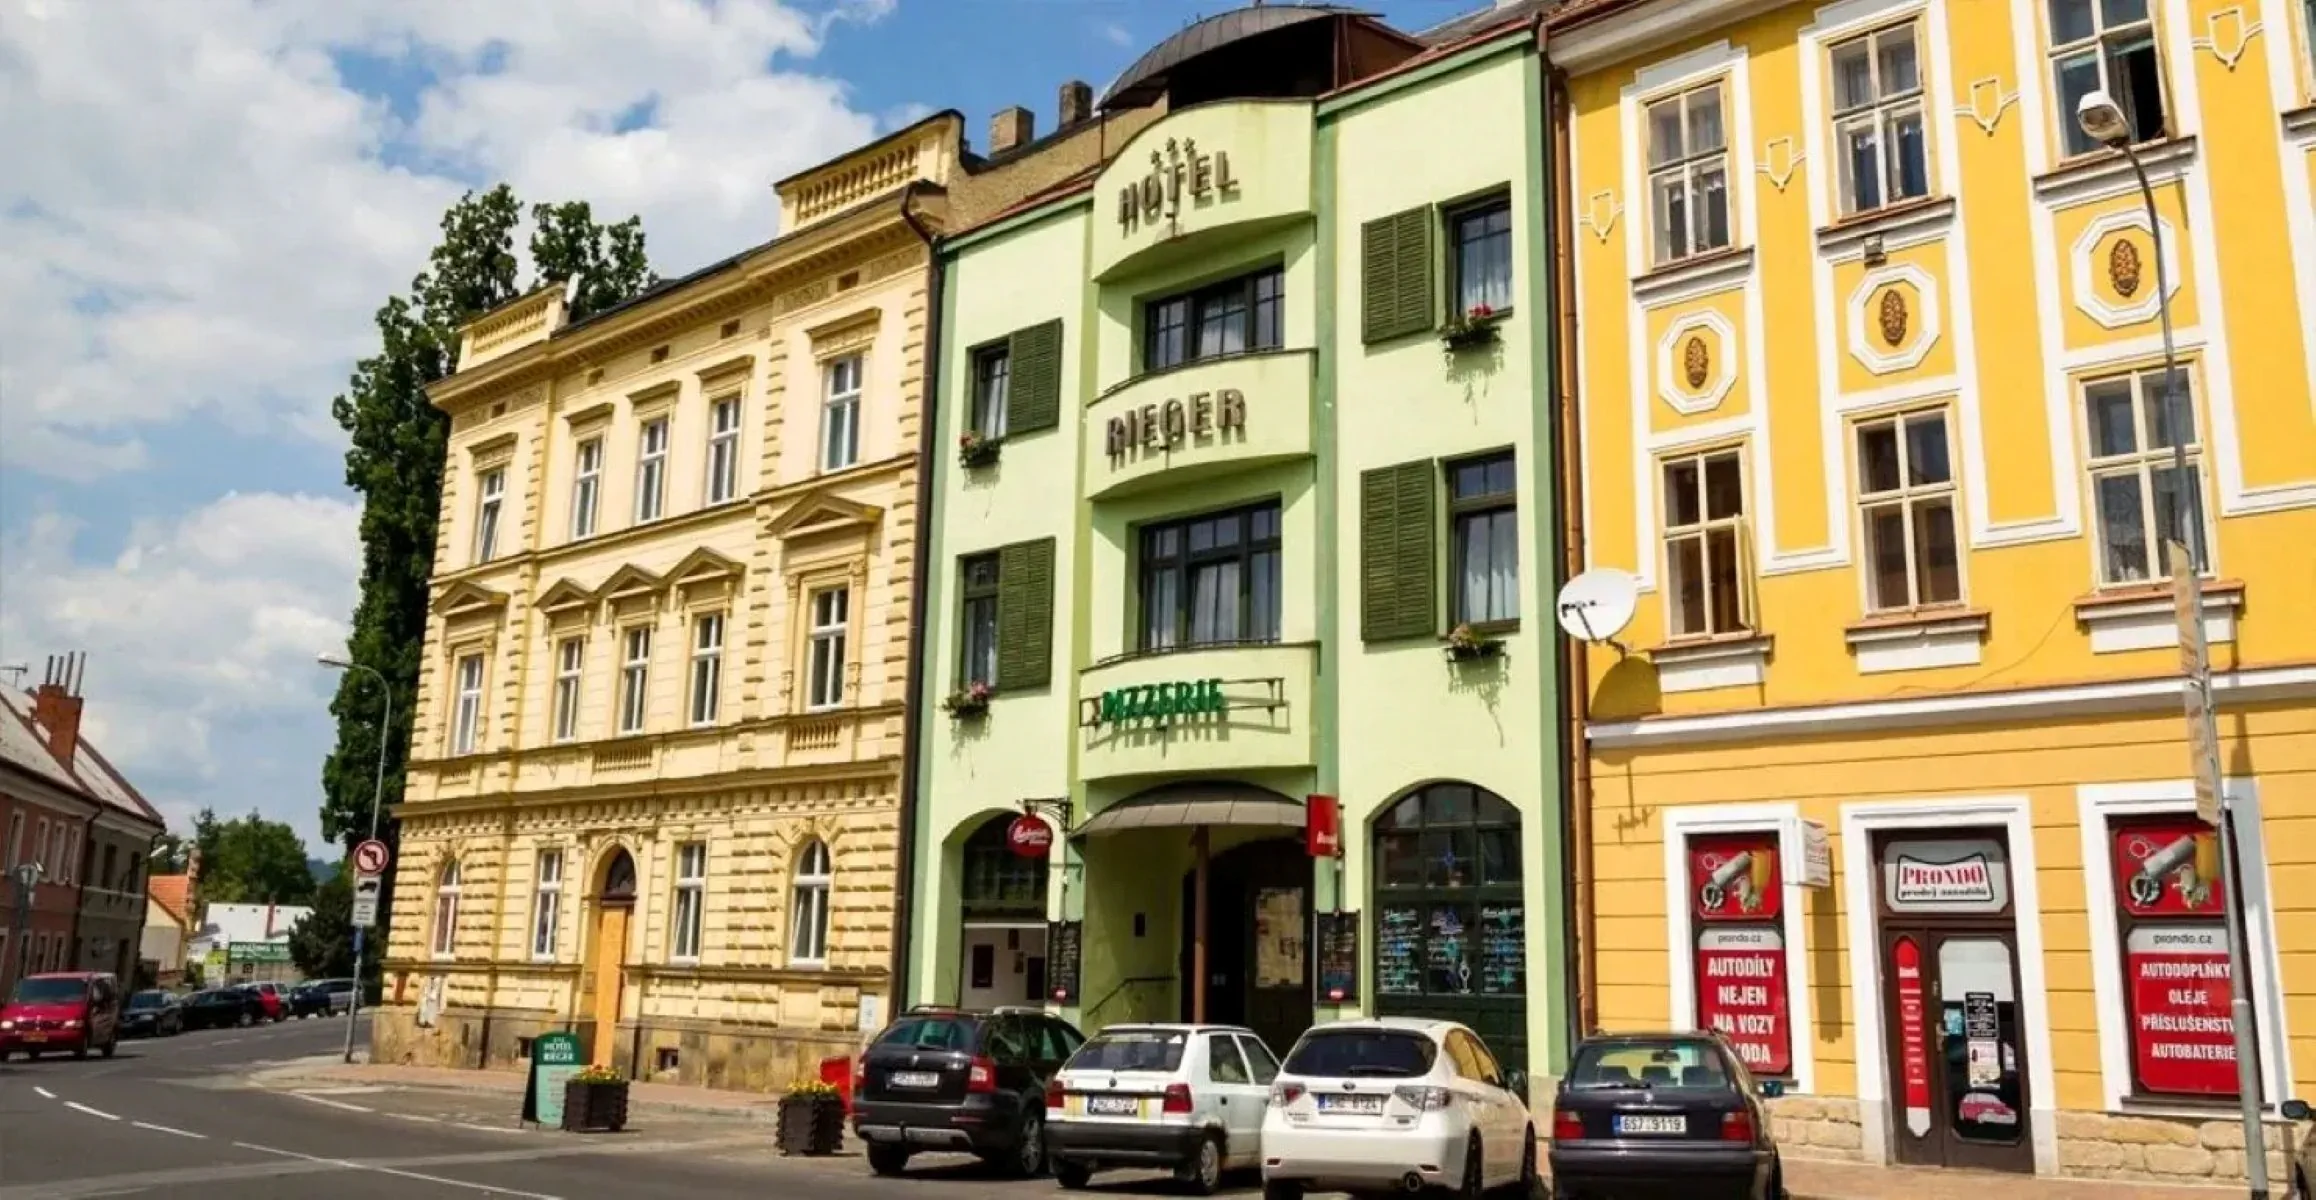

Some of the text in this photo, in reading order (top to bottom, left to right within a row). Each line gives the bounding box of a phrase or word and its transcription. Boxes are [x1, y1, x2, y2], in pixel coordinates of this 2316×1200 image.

[1118, 151, 1240, 225] HOTEL
[1105, 388, 1247, 458] RIEGER
[1902, 865, 1984, 885] PRONDO
[2152, 933, 2213, 944] prondo.cz
[1707, 954, 1775, 977] AUTODÍLY
[2140, 960, 2231, 978] AUTODOPLŇKY
[1718, 985, 1768, 1006] NEJEN
[2168, 988, 2208, 1005] OLEJE
[1712, 1013, 1776, 1035] NA VOZY
[2150, 1043, 2237, 1060] AUTOBATERIE
